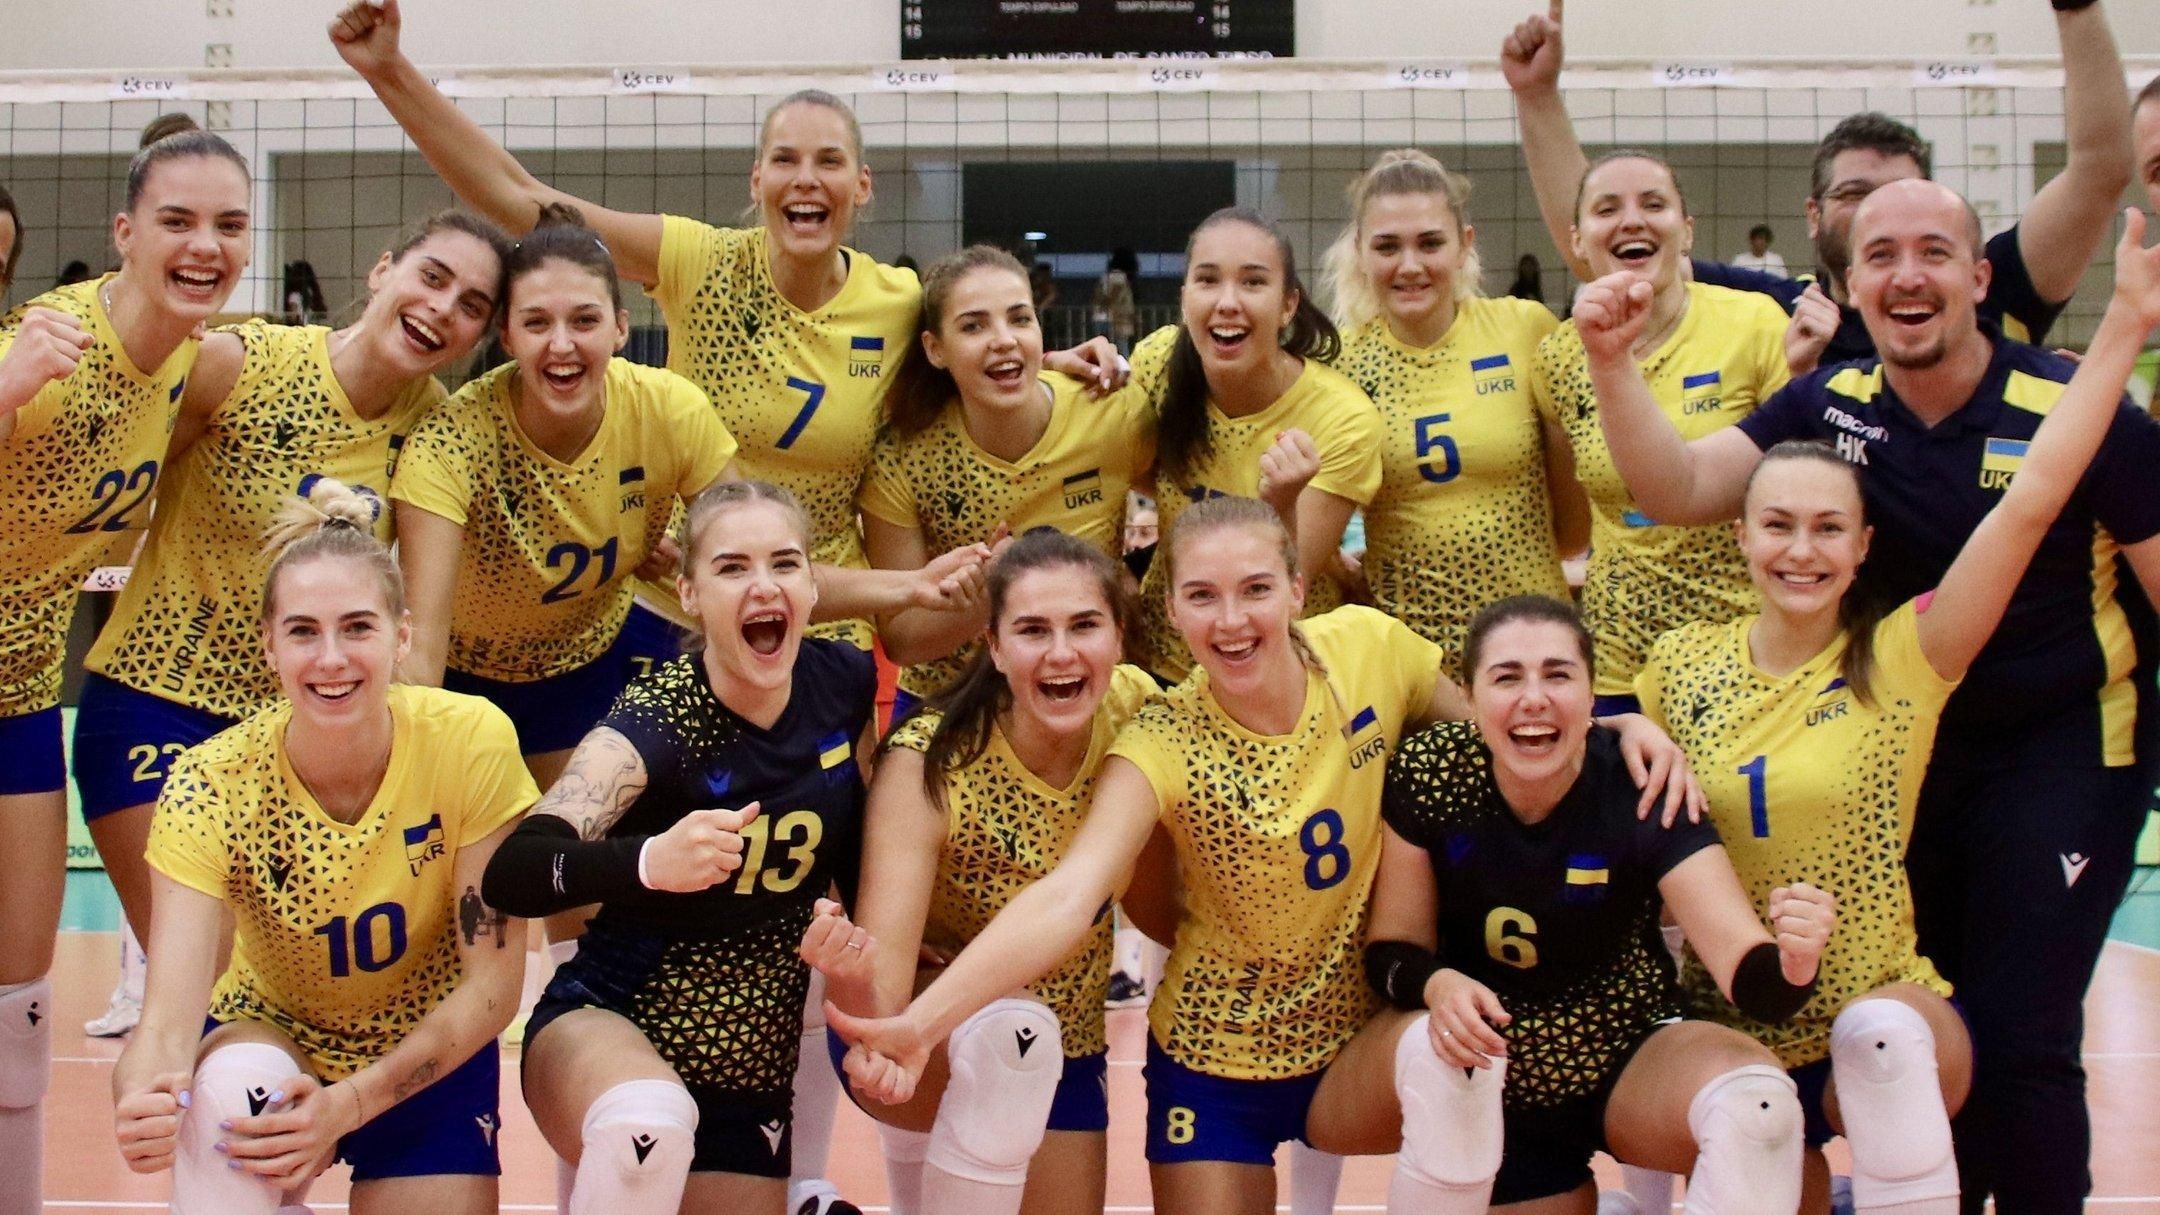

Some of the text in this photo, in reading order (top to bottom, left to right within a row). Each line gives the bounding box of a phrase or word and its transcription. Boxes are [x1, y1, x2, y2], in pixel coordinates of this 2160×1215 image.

[145, 81, 173, 90] CEV
[645, 75, 674, 84] CEV
[909, 73, 939, 82] CEV
[1174, 70, 1203, 79] CEV
[1423, 69, 1452, 79] CEV
[1689, 68, 1718, 77] CEV
[1951, 66, 1980, 75] CEV
[849, 363, 881, 378] UKR
[1476, 379, 1516, 396] UKR
[774, 376, 826, 450] 7
[1683, 397, 1721, 416] UKR
[1823, 406, 1889, 443] macron
[1414, 413, 1462, 484] 5
[1836, 431, 1869, 466] HK
[1979, 470, 2014, 491] UK
[64, 461, 158, 534] 22
[1065, 489, 1103, 510] UKR
[541, 536, 618, 604] 21
[162, 594, 219, 693] UKRAINE
[1806, 702, 1848, 727] UKR
[1350, 737, 1386, 770] UKR
[1738, 755, 1769, 838] 1
[734, 810, 823, 894] 13
[1300, 808, 1351, 890] 8
[314, 902, 408, 977] 10
[1485, 906, 1538, 969] 6
[1167, 1106, 1196, 1144] 8
